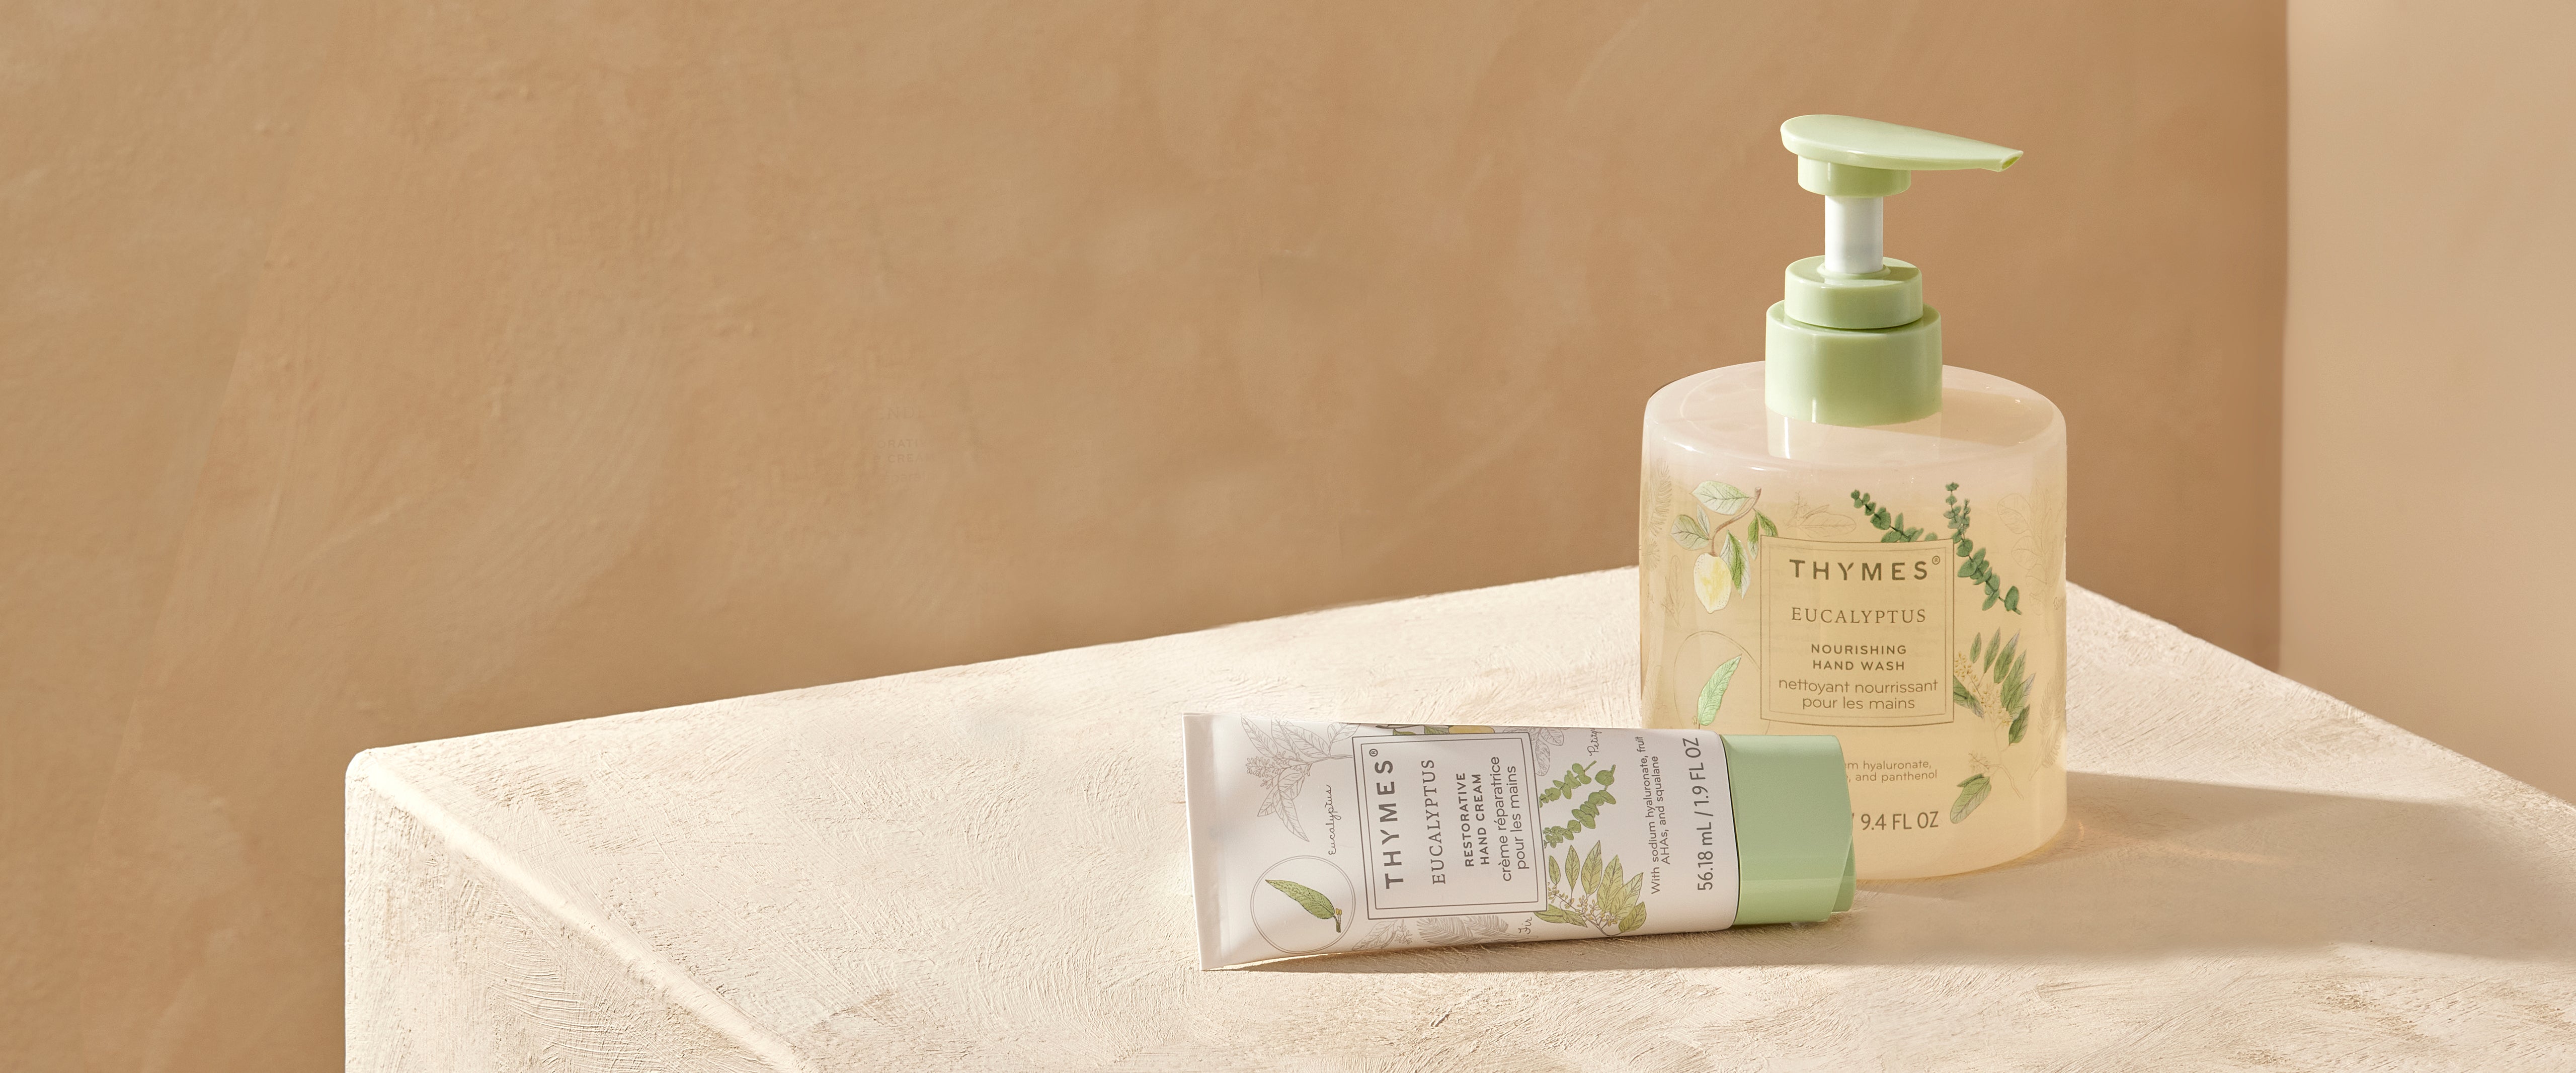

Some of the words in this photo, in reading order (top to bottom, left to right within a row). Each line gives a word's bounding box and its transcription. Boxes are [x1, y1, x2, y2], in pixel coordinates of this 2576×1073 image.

[1792, 607, 1925, 623] EUCALYPTUS
[1811, 644, 1906, 655] NOURISHING
[1813, 660, 1854, 671] HAND
[1861, 661, 1904, 671] WASH
[1779, 679, 1850, 695] nettoyant
[1855, 679, 1938, 694] nourrissant
[1803, 698, 1838, 710] pour
[1843, 696, 1864, 709] les
[1870, 697, 1915, 709] mains
[1635, 736, 1646, 753] fruit
[1682, 737, 1701, 758] OZ
[1688, 762, 1706, 780] FL
[1856, 772, 1877, 781] and
[1882, 769, 1937, 783] panthenol
[1863, 760, 1931, 772] hyaluronate,
[1506, 766, 1520, 808] mains
[1640, 756, 1656, 818] hyaluronate,
[1652, 756, 1664, 801] squalane
[1471, 774, 1485, 821] CREAM
[1490, 757, 1509, 831] réparatrice
[1692, 786, 1709, 806] 1.9
[1324, 784, 1342, 857] Eucalyptus
[1421, 760, 1445, 884] EUCALYPTUS
[1456, 773, 1474, 867] RESTORATIVE
[1510, 813, 1522, 832] les
[1655, 805, 1666, 825] and
[1861, 813, 1887, 830] 9.4
[1893, 813, 1912, 830] FL
[1917, 811, 1939, 829] OZ
[1649, 821, 1659, 862] sodium
[1697, 821, 1713, 845] mL
[1477, 828, 1490, 865] HAND
[1498, 836, 1511, 881] crème
[1514, 837, 1530, 869] pour
[1659, 830, 1670, 865] AHAs,
[1650, 867, 1660, 894] With
[1698, 851, 1713, 890] 56.18
[1518, 917, 1532, 935] Fir
